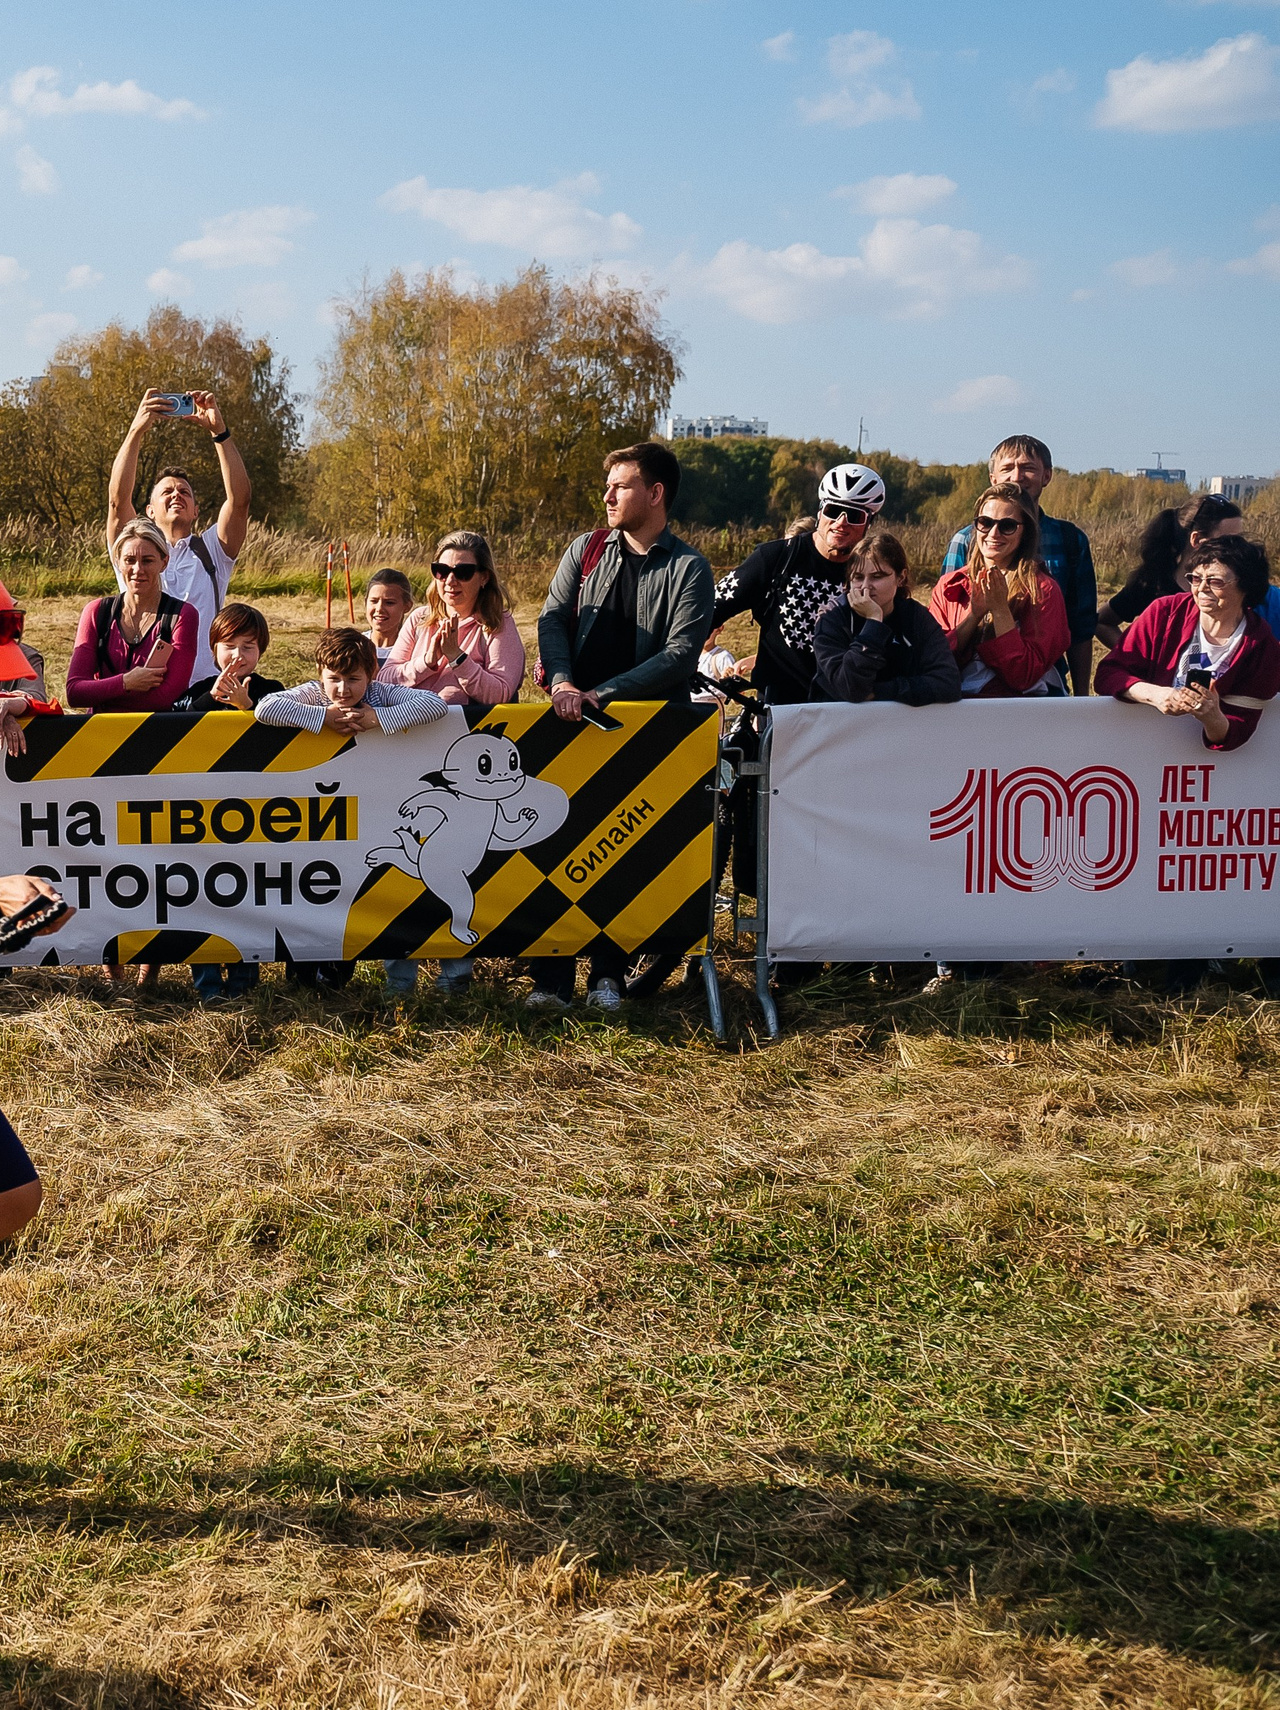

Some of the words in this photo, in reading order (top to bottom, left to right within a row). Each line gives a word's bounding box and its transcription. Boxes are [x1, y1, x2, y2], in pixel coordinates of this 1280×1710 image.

[1159, 764, 1215, 803] ЛЕТ
[20, 800, 106, 847] на
[127, 781, 347, 844] твоей
[929, 764, 1140, 894] 100
[1159, 808, 1280, 848] МОСКОВ
[564, 798, 656, 884] билайн
[1158, 852, 1277, 892] СПОРТУ
